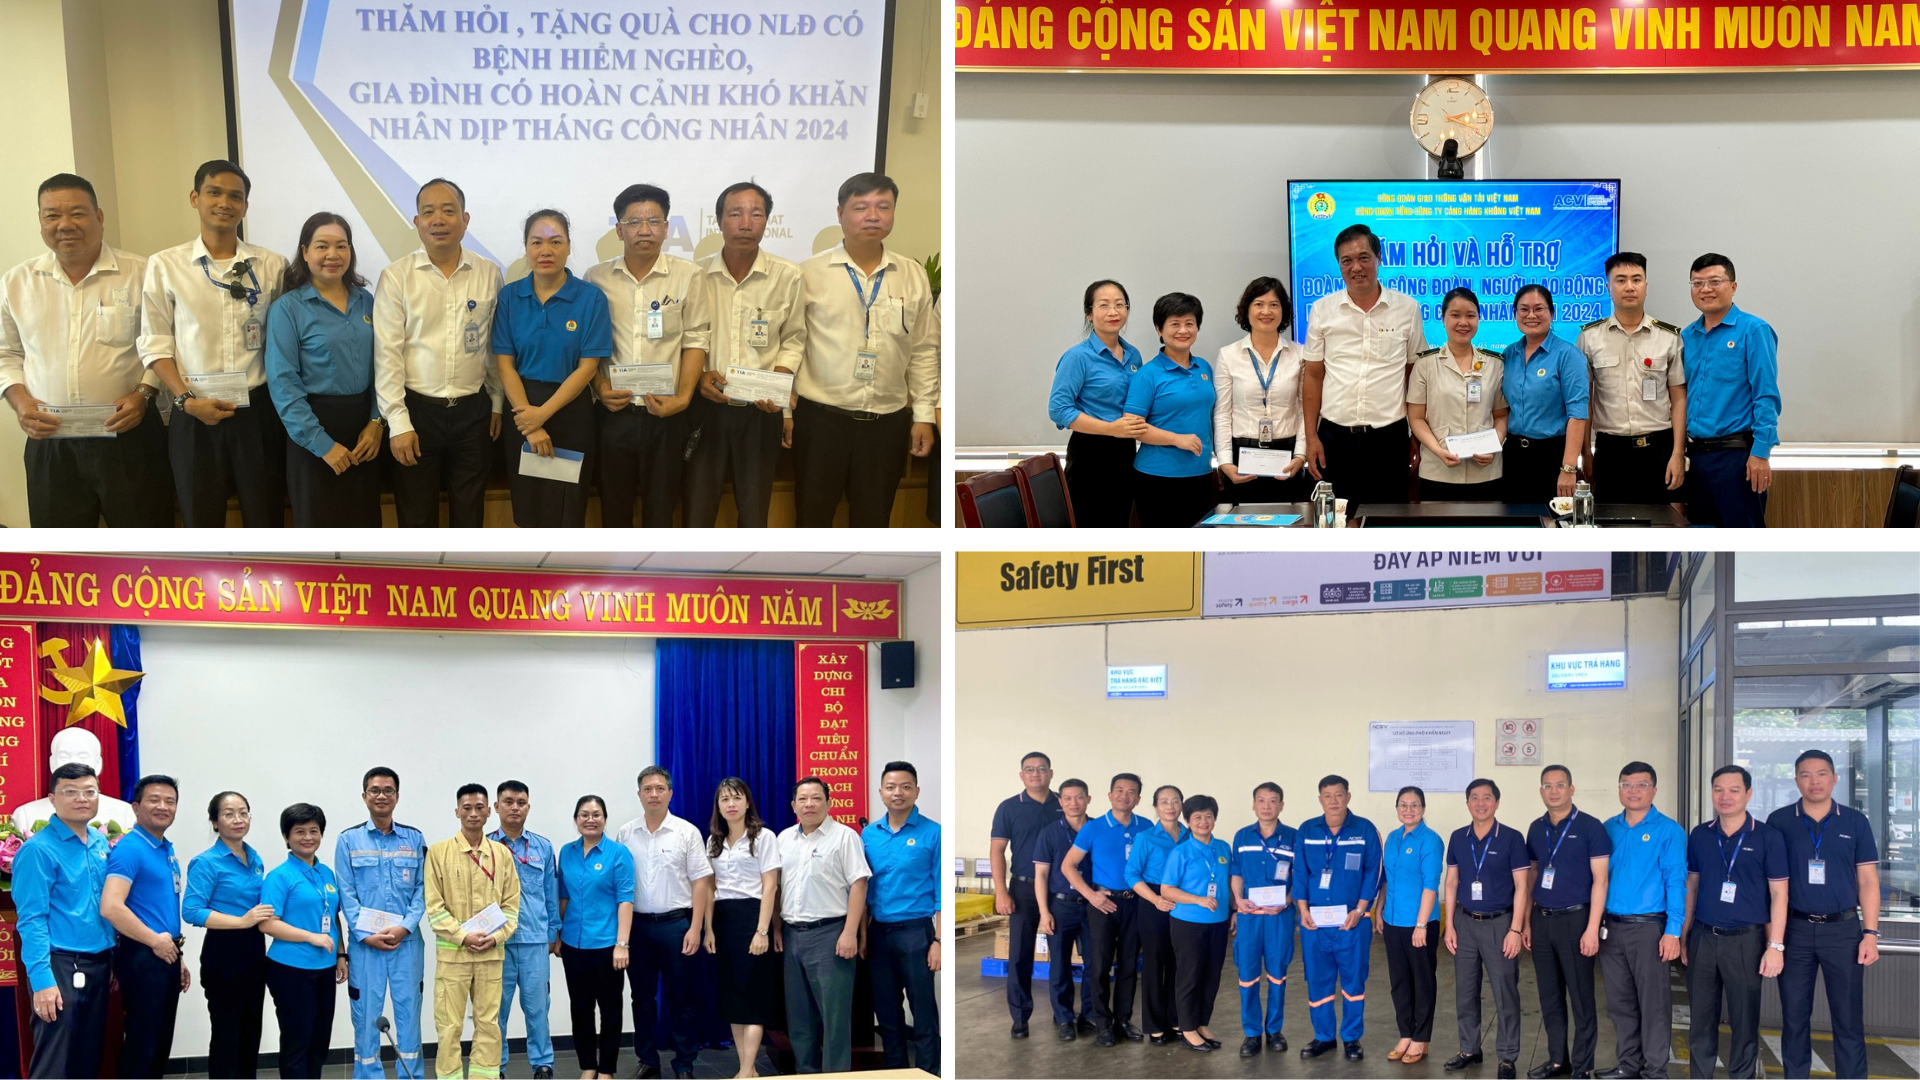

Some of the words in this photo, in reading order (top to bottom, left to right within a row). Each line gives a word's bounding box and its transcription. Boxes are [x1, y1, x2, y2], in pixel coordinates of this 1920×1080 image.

[355, 3, 447, 34] THĂM
[454, 4, 509, 34] HỎI
[530, 8, 612, 40] TẶNG
[619, 7, 681, 40] QUÀ
[688, 13, 752, 36] CHO
[758, 13, 817, 37] NLĐ
[823, 9, 865, 37] CÓ
[1369, 8, 1457, 51] NAM
[1469, 7, 1596, 56] QUANG
[1610, 7, 1700, 50] VINH
[472, 44, 552, 76] BỆNH
[560, 42, 637, 71] HIỂM
[644, 43, 754, 75] NGHÈO,
[348, 81, 404, 105] GIA
[408, 76, 483, 106] ĐÌNH
[490, 77, 533, 106] CÓ
[540, 78, 623, 106] HOÀN
[629, 78, 710, 106] CẢNH
[718, 78, 781, 107] KHÓ
[788, 79, 868, 107] KHĂN
[368, 110, 451, 140] NHÂN
[459, 118, 508, 146] DỊP
[513, 112, 614, 141] THÁNG
[620, 112, 702, 141] CÔNG
[708, 112, 789, 140] NHÂN
[794, 118, 849, 141] 2024
[1504, 194, 1518, 202] NAM
[1553, 194, 1584, 206] ACV
[1412, 234, 1448, 268] HỎI
[1452, 237, 1482, 268] VÀ
[1486, 232, 1515, 268] HỖ
[1519, 239, 1562, 272] TRỢ
[1563, 274, 1606, 300] ĐỘNG
[1561, 302, 1602, 323] 2024
[1000, 560, 1079, 592] Safety
[1087, 554, 1145, 586] First
[0, 558, 100, 607] ĐẢNG
[112, 565, 206, 618] CỘNG
[218, 566, 283, 613] SẢN
[295, 573, 372, 622] VIỆT
[386, 584, 458, 619] NAM
[468, 586, 572, 622] QUANG
[579, 588, 656, 624] VINH
[666, 585, 749, 626] MUÔN
[760, 587, 823, 627] NĂM
[817, 652, 848, 664] XÂY
[1550, 661, 1566, 670] KHU
[814, 670, 854, 682] DỰNG
[821, 687, 845, 696] CHI
[824, 701, 844, 714] BỘ
[820, 719, 848, 730] ĐẠT
[818, 733, 850, 744] TIÊU
[810, 746, 858, 760] CHUẨN
[810, 767, 858, 776] TRONG
